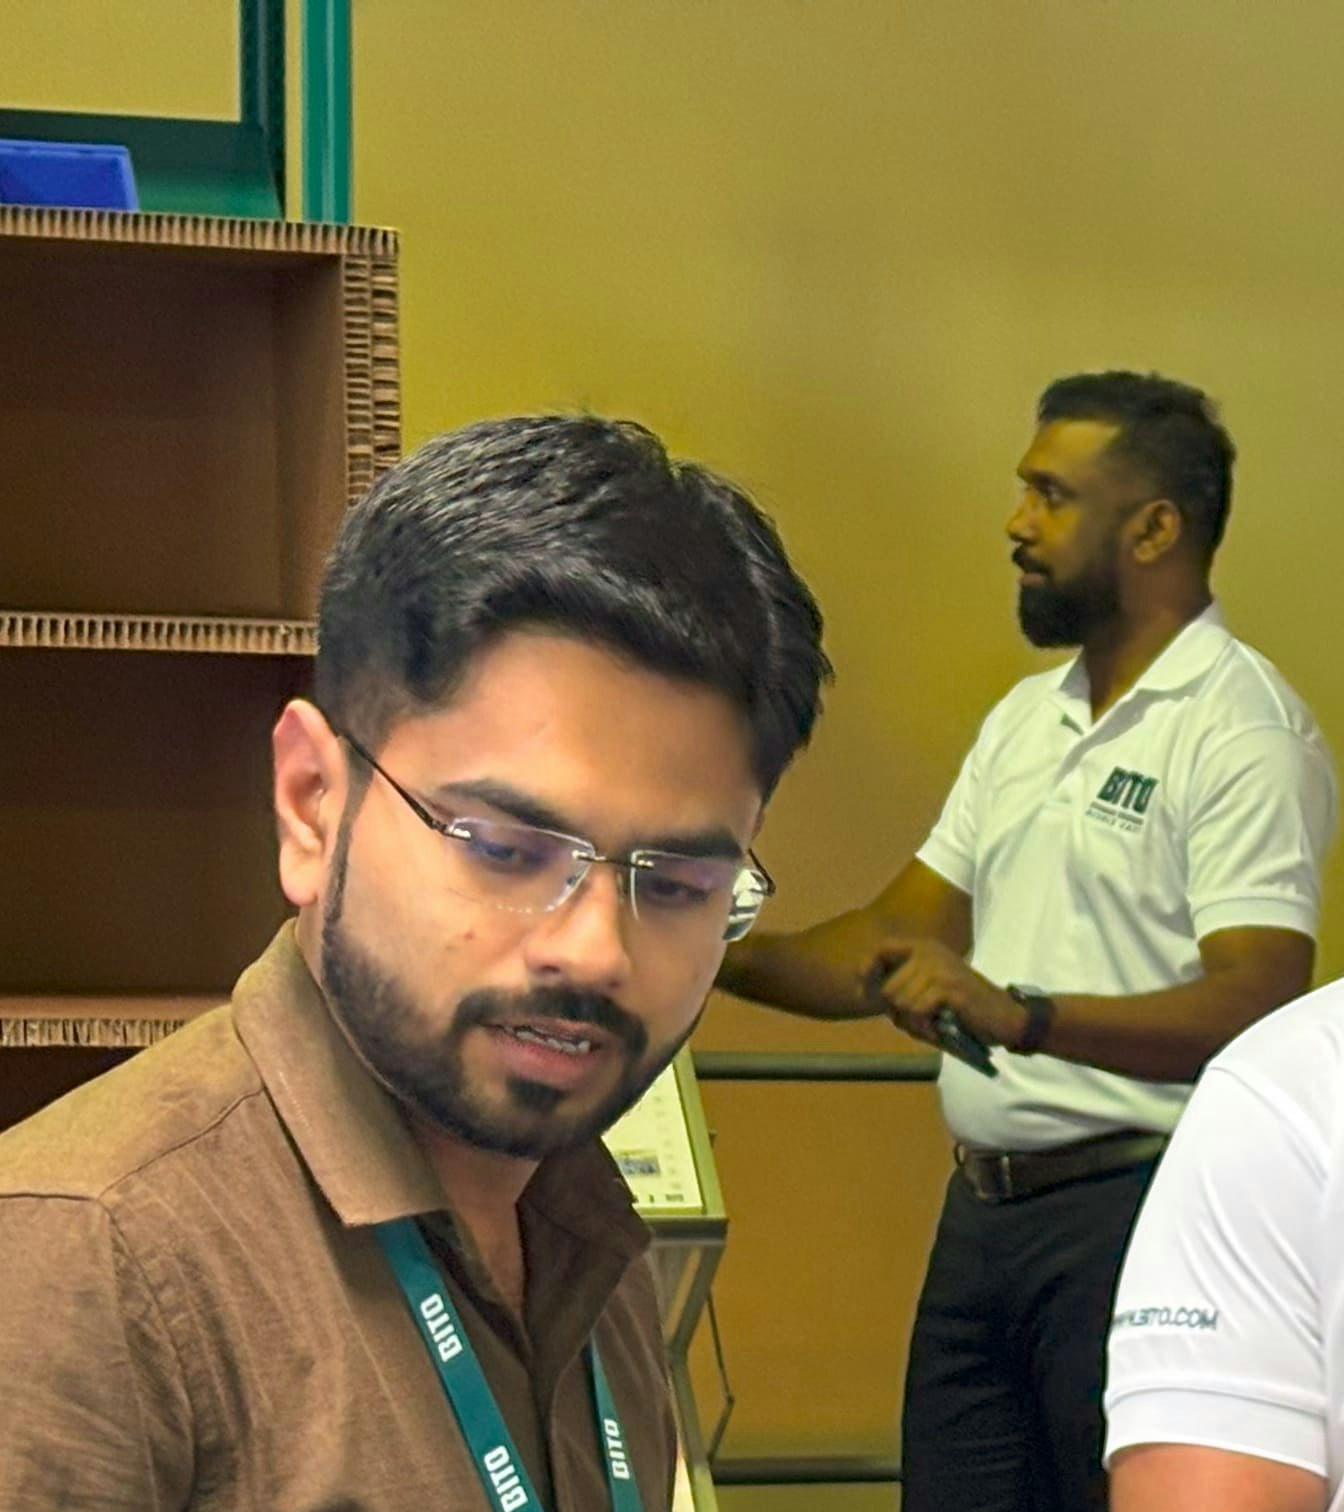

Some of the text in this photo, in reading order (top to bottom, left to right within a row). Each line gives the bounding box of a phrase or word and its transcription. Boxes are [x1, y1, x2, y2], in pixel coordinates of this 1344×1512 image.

[1097, 766, 1160, 815] BITO
[419, 1293, 463, 1363] BITO
[604, 1418, 631, 1480] BITO
